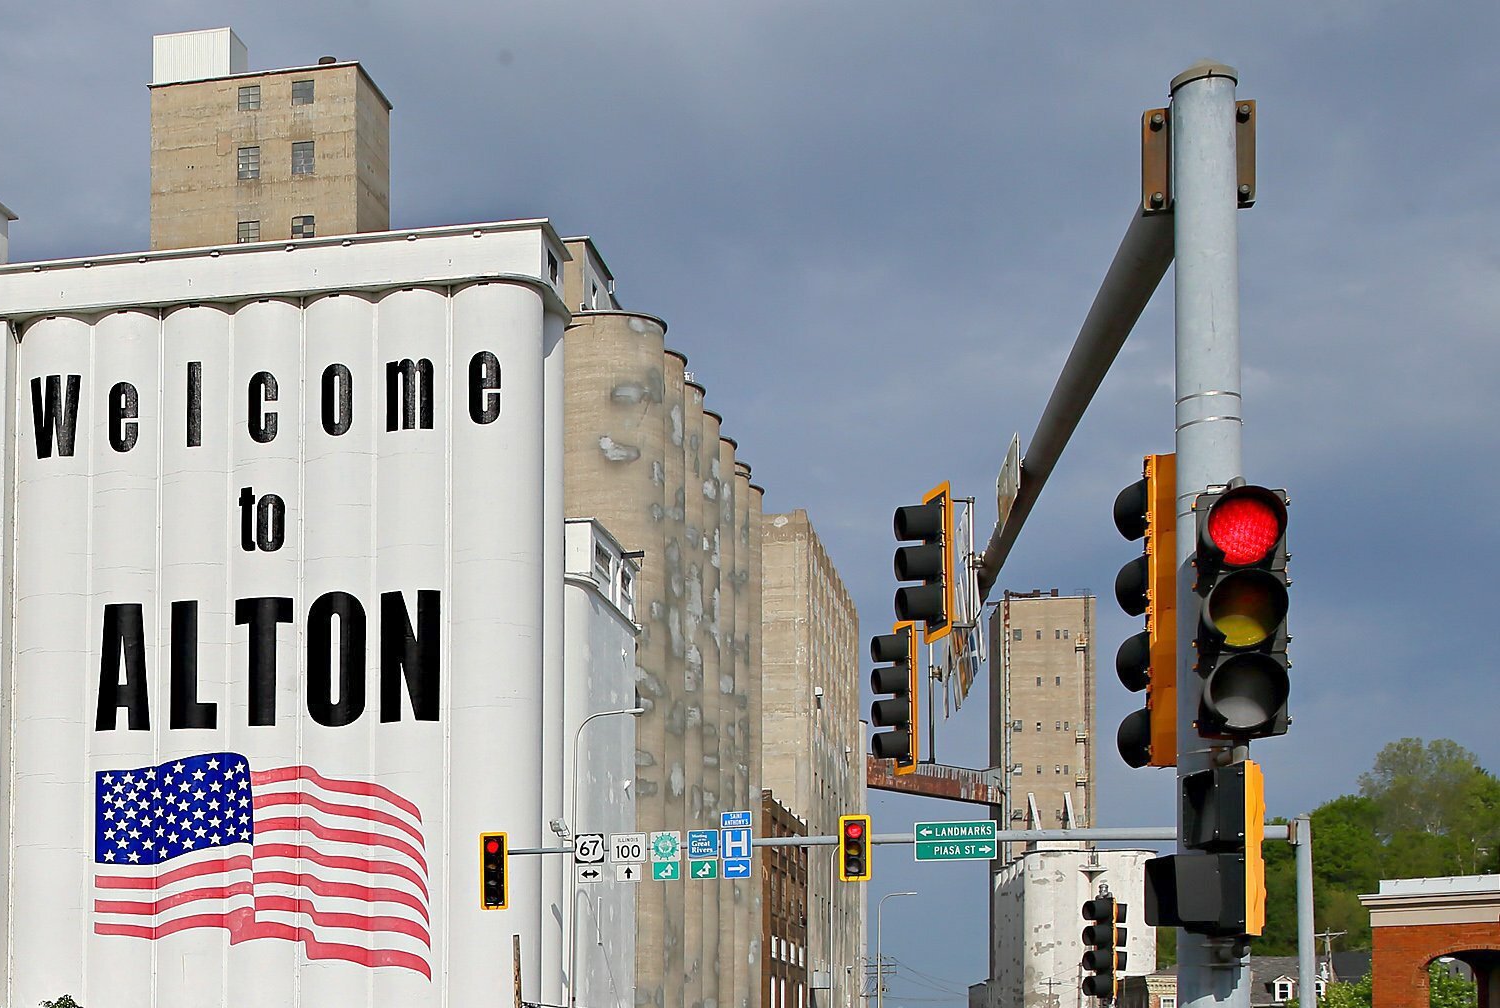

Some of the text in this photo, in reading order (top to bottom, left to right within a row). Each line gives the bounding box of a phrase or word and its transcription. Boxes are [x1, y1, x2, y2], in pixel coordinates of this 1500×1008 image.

[31, 351, 501, 459] Welcome
[239, 487, 286, 552] to
[95, 589, 441, 731] ALTON
[935, 825, 992, 837] LANDMARKS
[579, 840, 600, 857] 67
[616, 844, 641, 859] 100
[934, 845, 976, 855] PIASA ST
